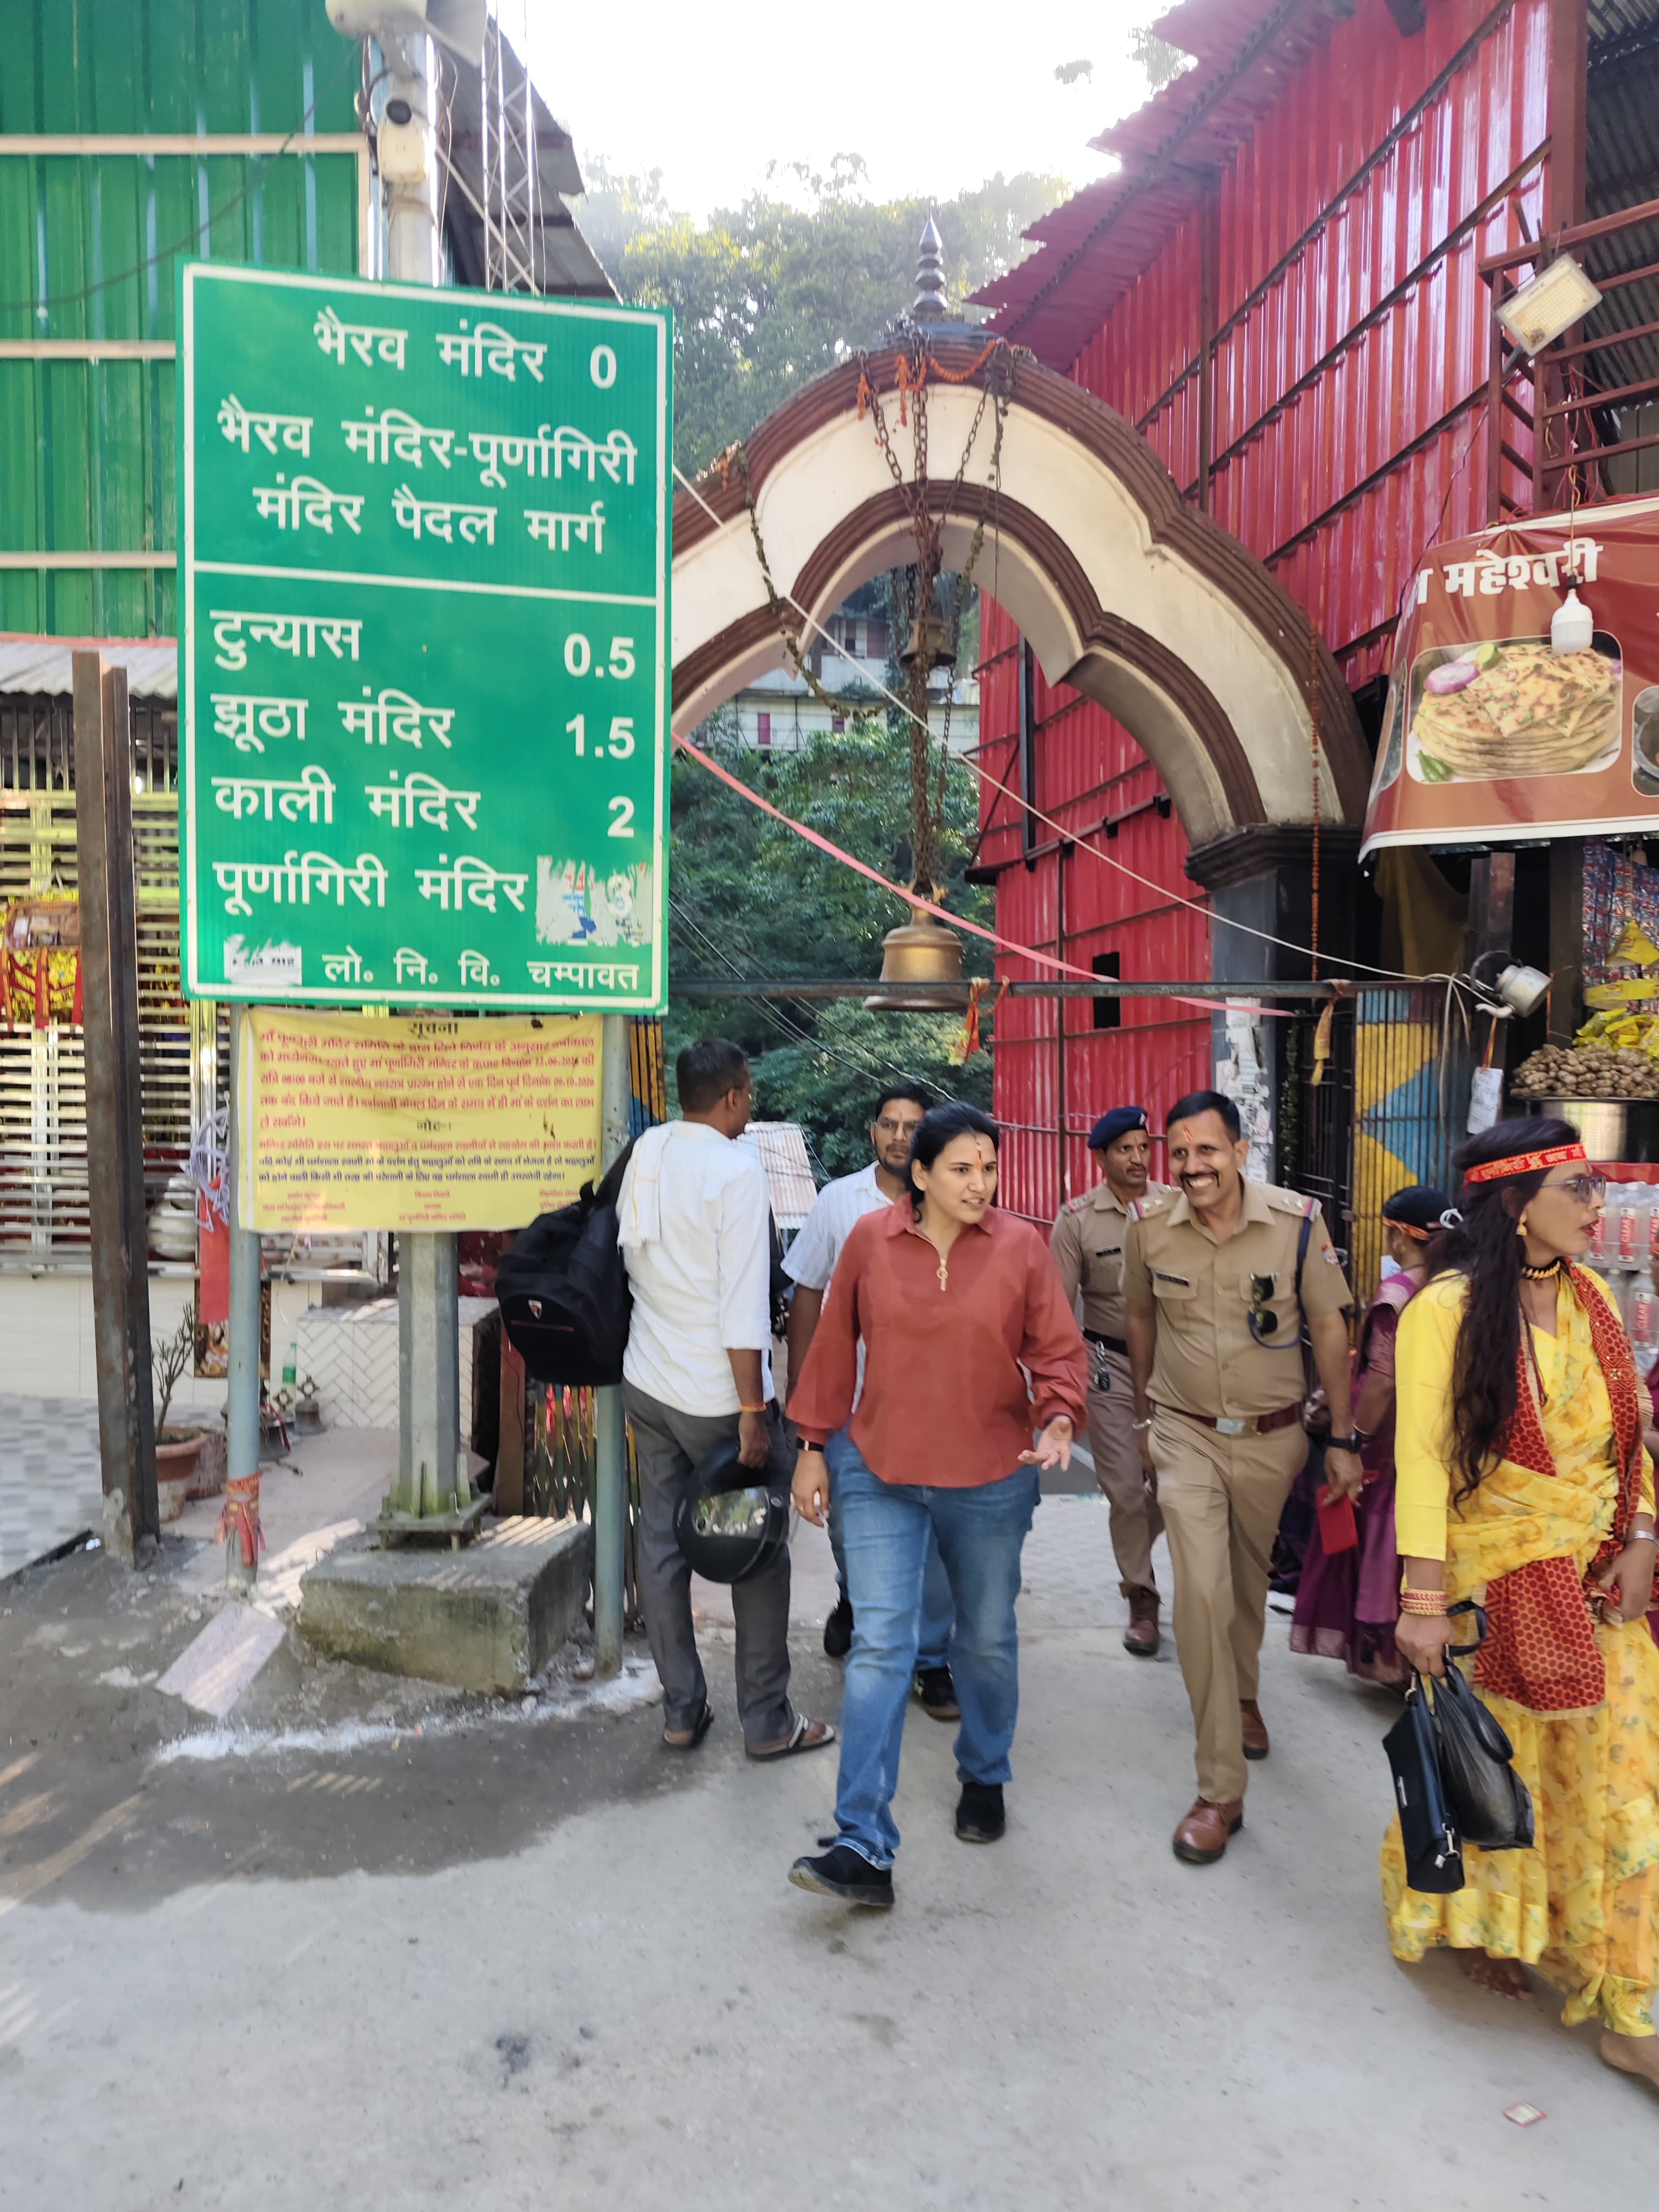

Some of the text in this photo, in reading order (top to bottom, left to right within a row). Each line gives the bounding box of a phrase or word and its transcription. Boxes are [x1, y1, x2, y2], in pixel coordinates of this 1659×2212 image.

[314, 306, 616, 388] भैरव मंदिर 0
[218, 394, 637, 488] भैरव मंदिर-पूर्णागिरी
[253, 473, 605, 554] मंदिर पैदल मार्ग
[1444, 537, 1603, 597] महेश्वरी
[210, 611, 635, 679] टुन्यास 0.5
[211, 686, 635, 758] झूठा मंदिर 1.5
[212, 765, 634, 837] काली मंदिर 2
[213, 850, 388, 916] पूर्णागिरी
[415, 854, 528, 913] मंदिर
[527, 961, 639, 991] चम्पावत
[408, 1022, 458, 1038] सूचना
[487, 1074, 503, 1088] दिन
